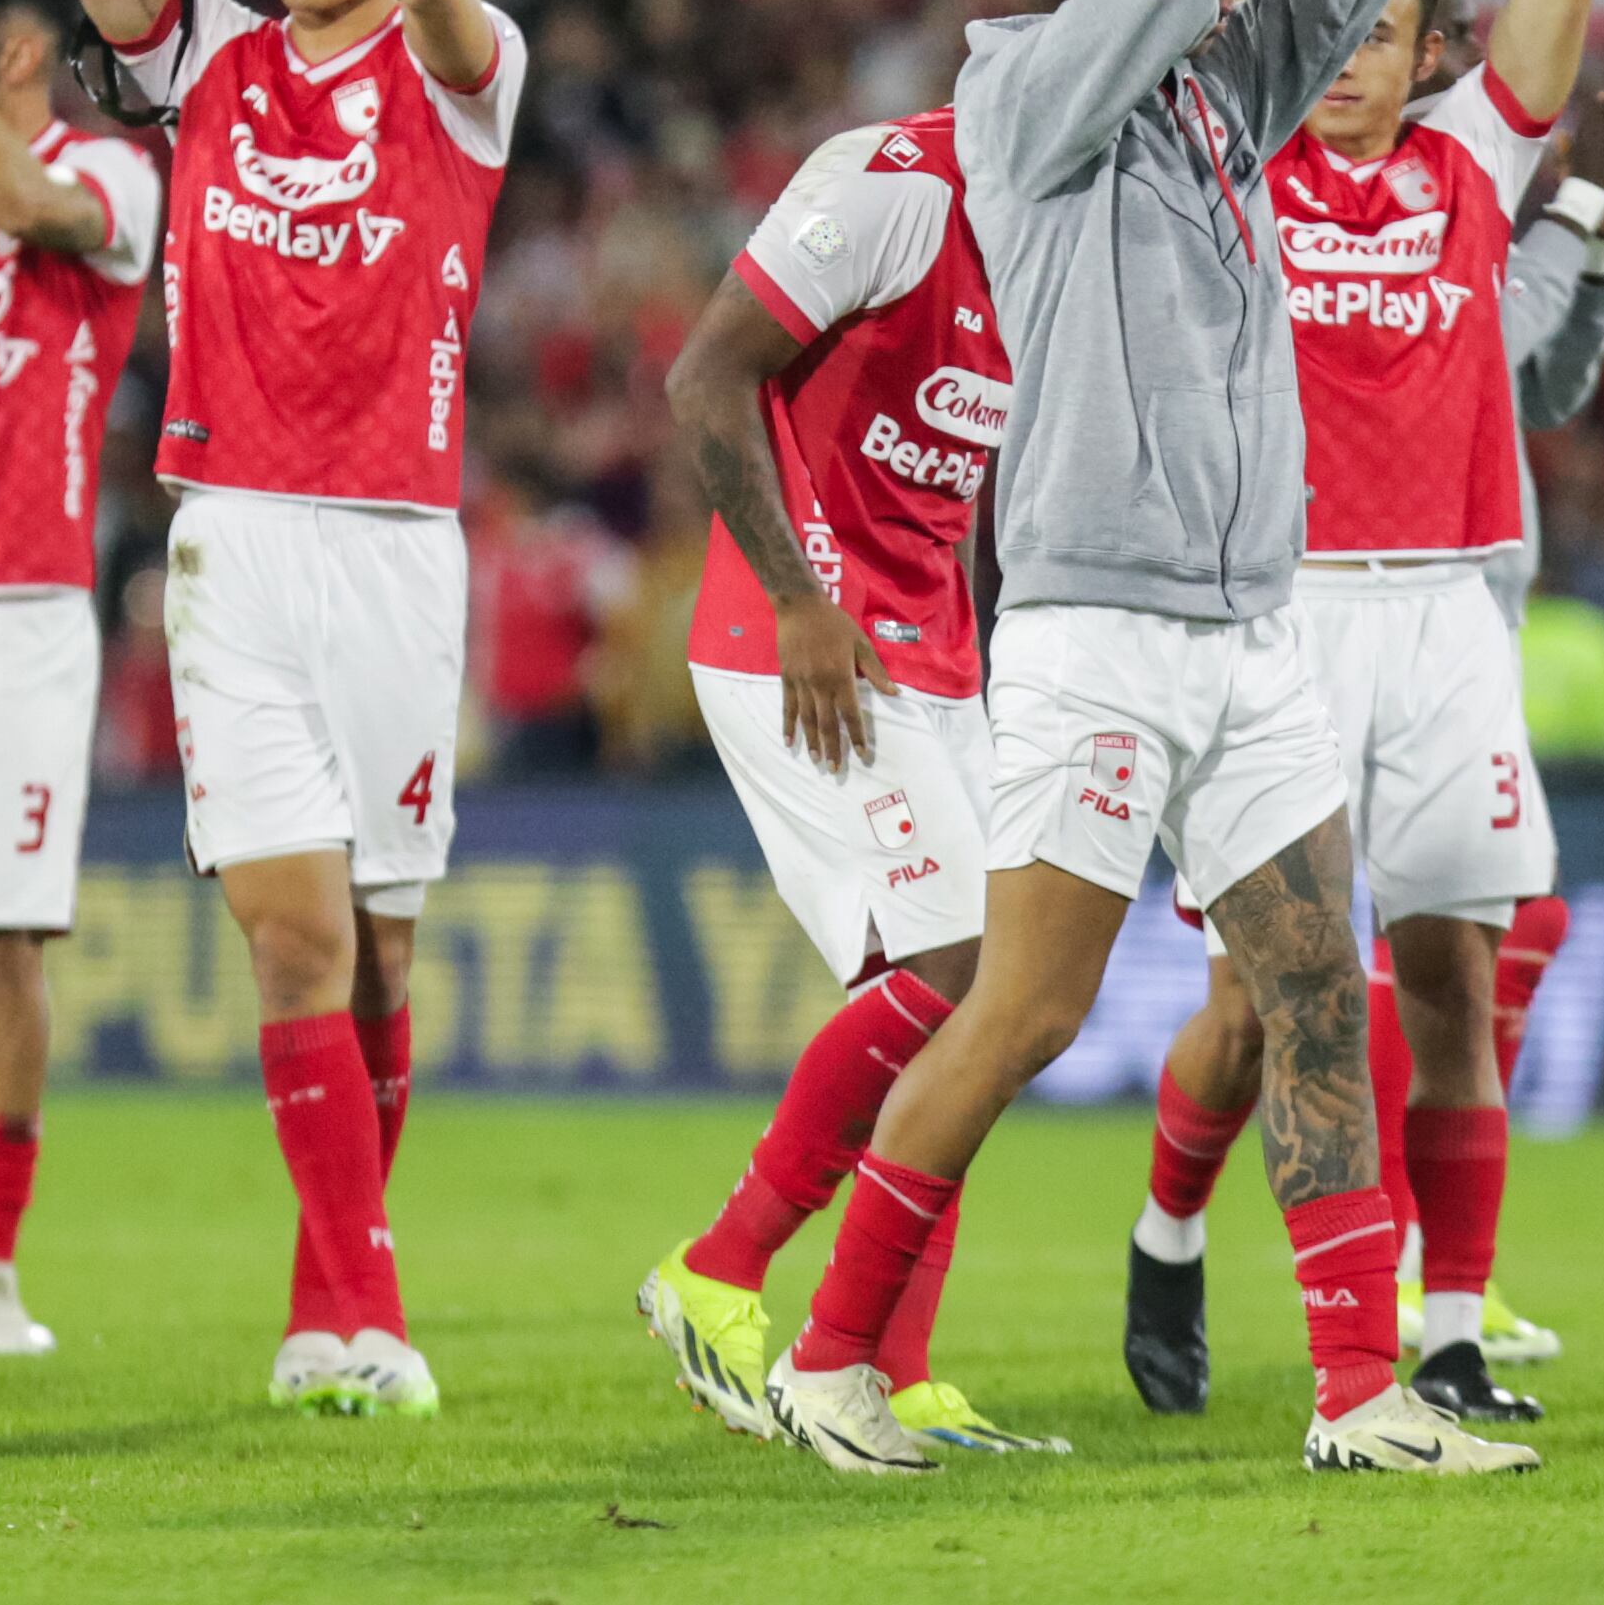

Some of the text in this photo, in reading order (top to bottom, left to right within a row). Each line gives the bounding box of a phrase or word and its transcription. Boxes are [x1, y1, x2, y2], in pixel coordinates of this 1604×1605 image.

[954, 306, 984, 334] FILA
[1282, 276, 1430, 338] etPlay
[924, 376, 1009, 431] Colan
[396, 751, 436, 826] 4
[1078, 787, 1131, 821] FILA
[14, 783, 52, 854] 3
[886, 856, 940, 889] FILA
